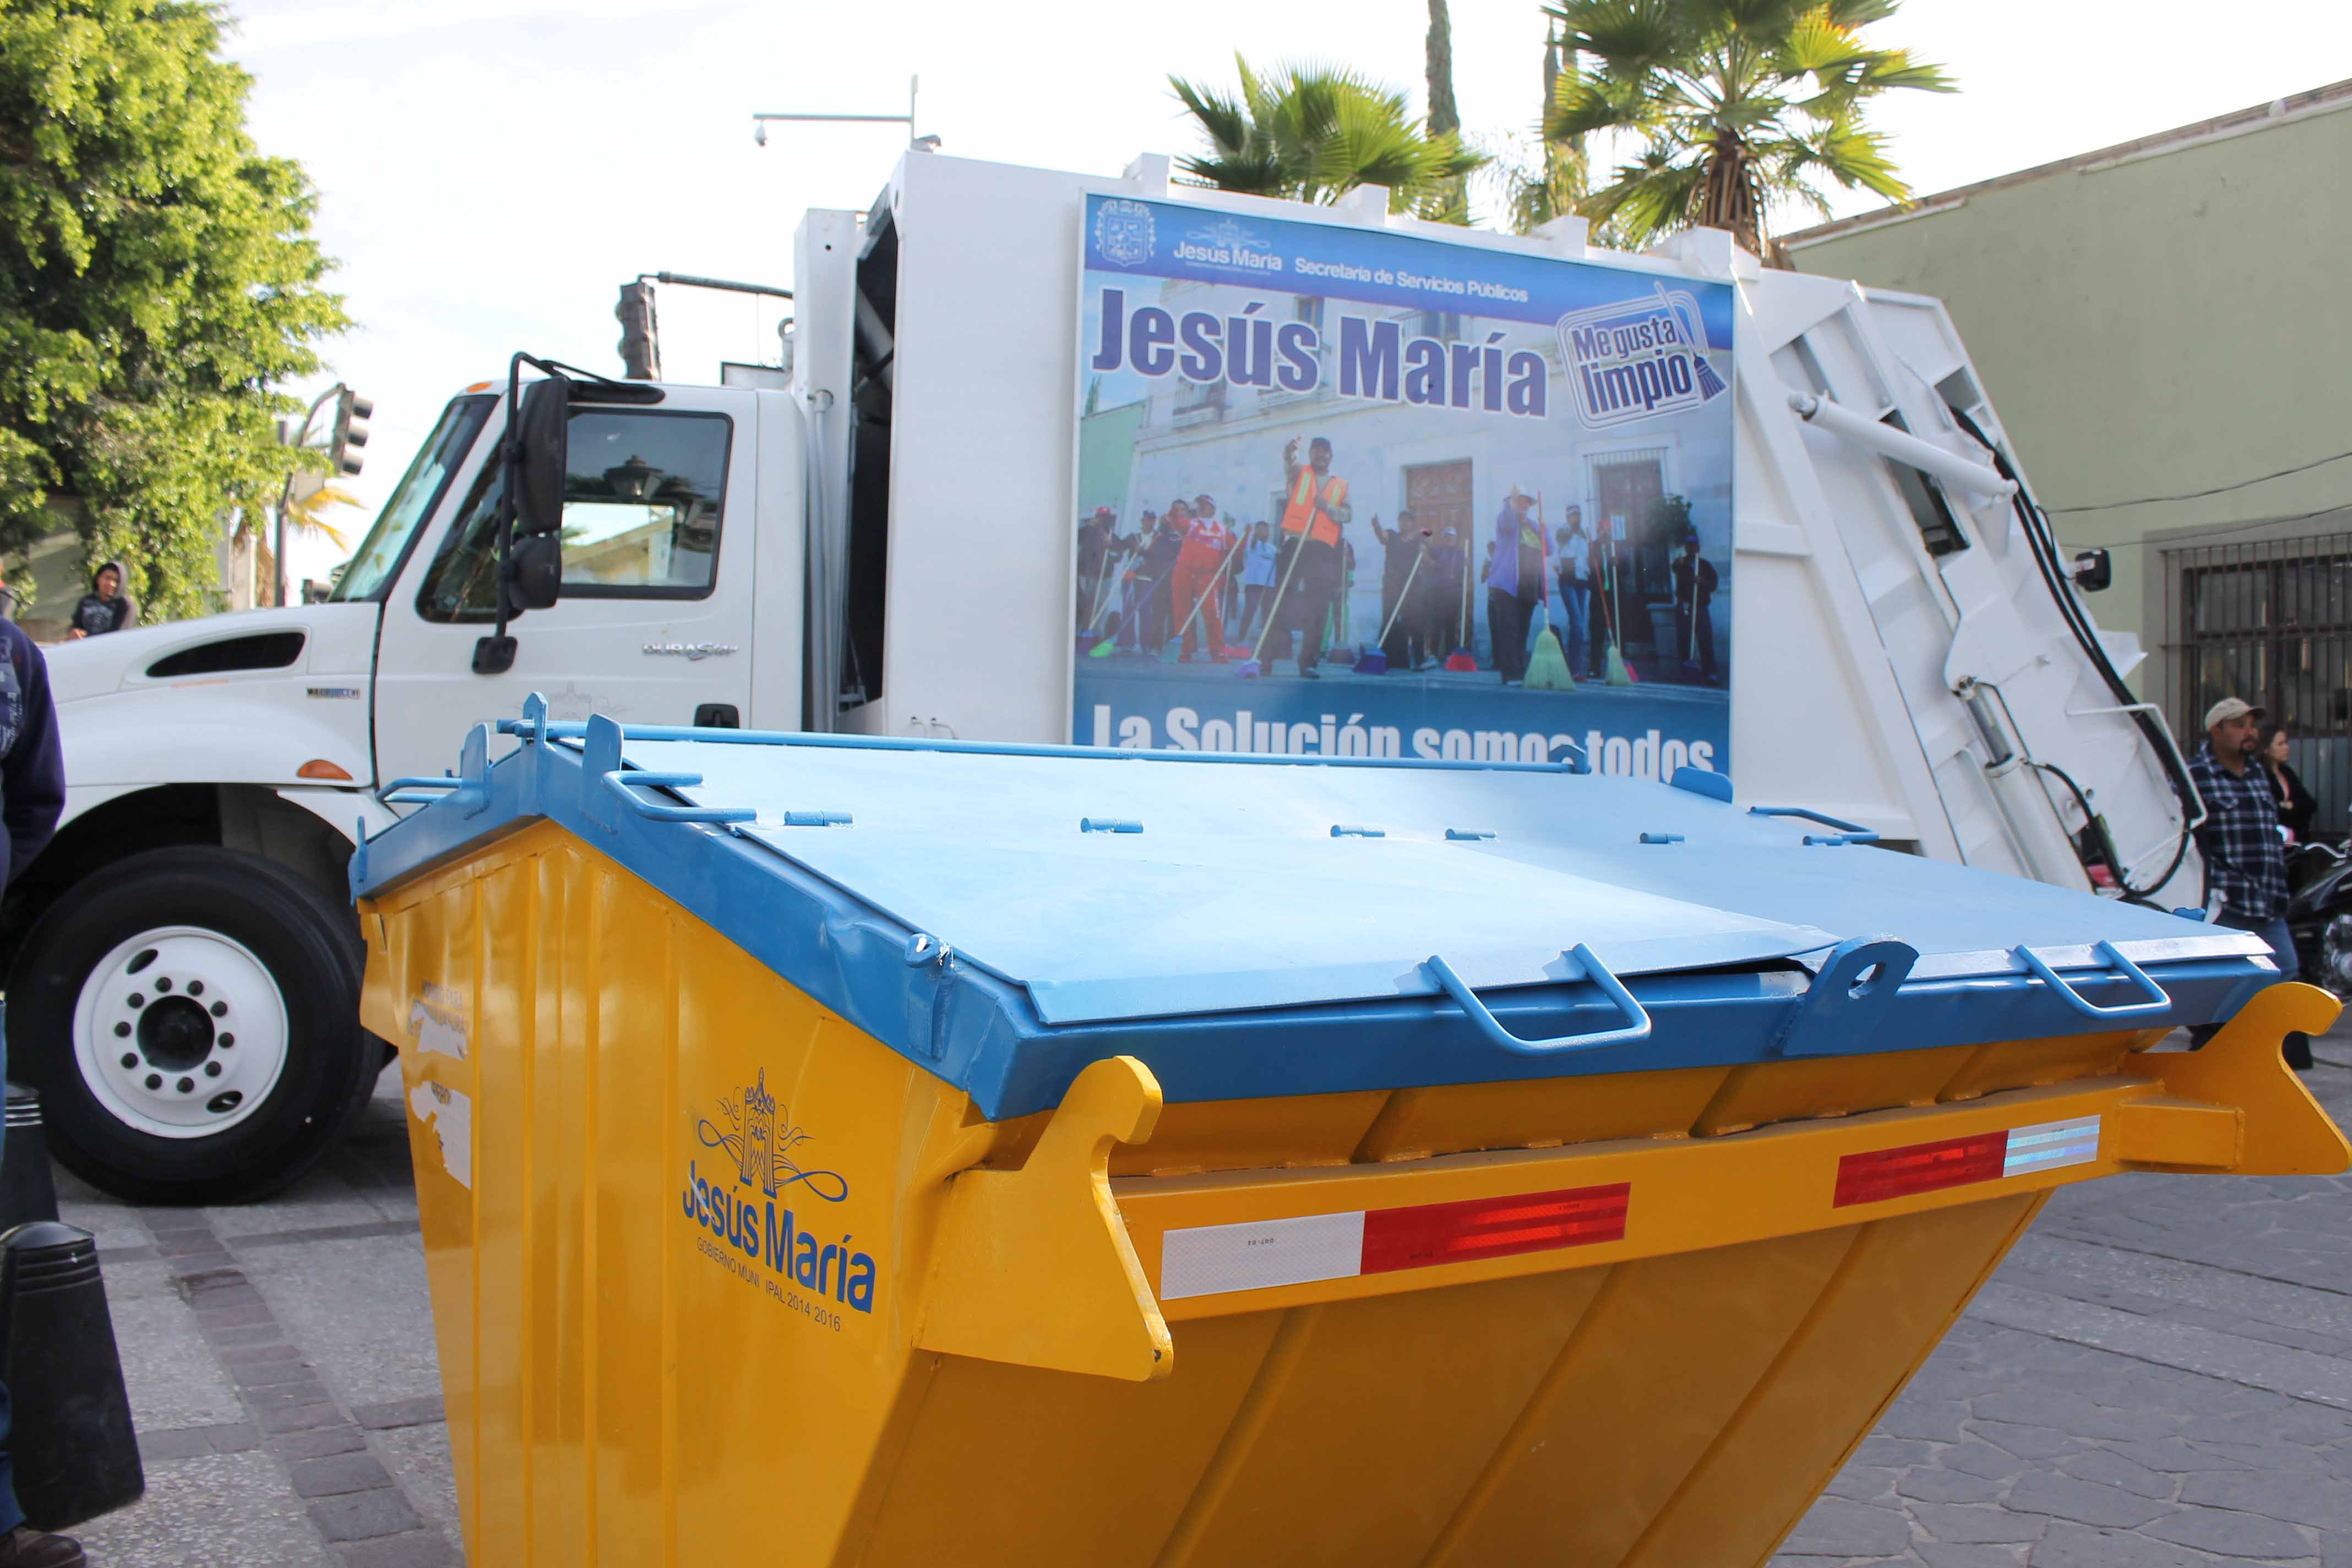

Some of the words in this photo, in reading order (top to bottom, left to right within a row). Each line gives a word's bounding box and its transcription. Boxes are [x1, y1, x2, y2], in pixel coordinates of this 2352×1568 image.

[1173, 241, 1230, 264] Jesús
[1233, 248, 1283, 271] María
[1374, 268, 1393, 286] de
[1397, 271, 1464, 295] Servicios
[1467, 279, 1528, 303] Públicos
[1092, 287, 1319, 392] Jesús
[1338, 315, 1548, 417] María
[1572, 329, 1611, 361] Me
[1613, 318, 1677, 359] gusta
[1579, 349, 1692, 414] limpio
[1094, 705, 1152, 749] La
[1166, 706, 1400, 758] Solución
[1586, 729, 1713, 784] todos
[683, 1159, 759, 1257] Jesús
[765, 1201, 876, 1314] María
[697, 1237, 736, 1273] GOBIERNO
[788, 1292, 810, 1317] 2014
[814, 1306, 841, 1332] 2016
